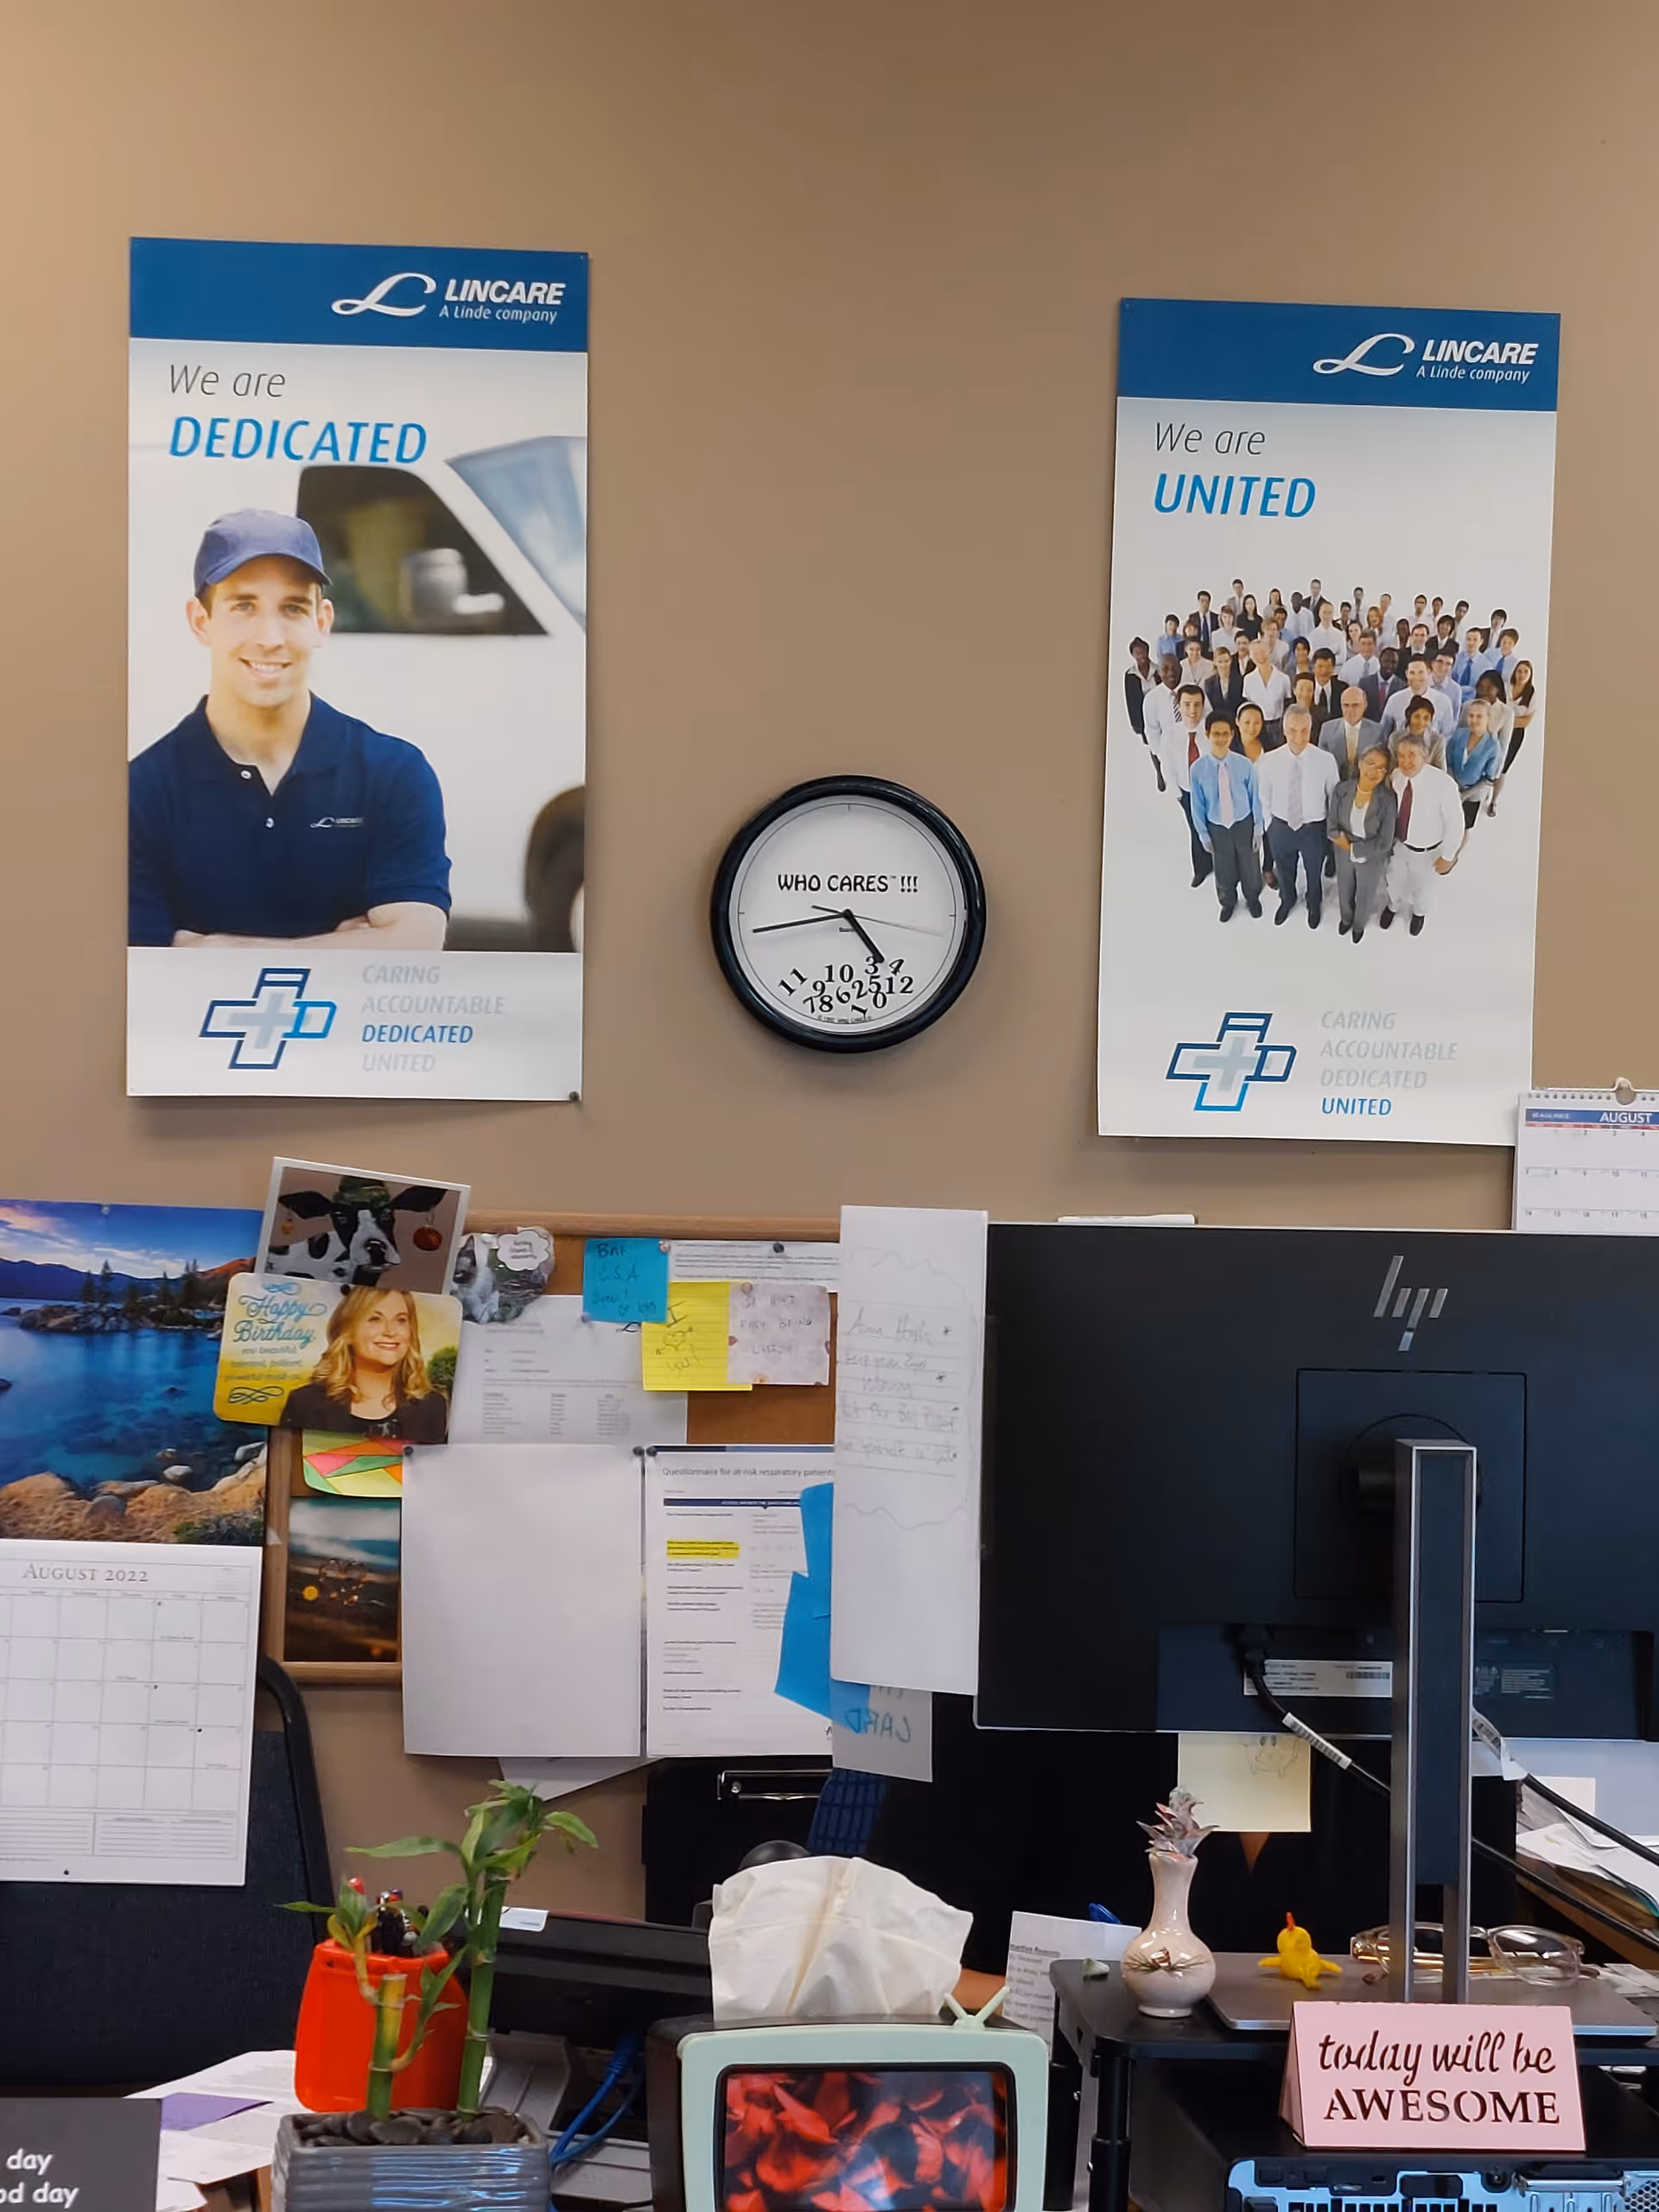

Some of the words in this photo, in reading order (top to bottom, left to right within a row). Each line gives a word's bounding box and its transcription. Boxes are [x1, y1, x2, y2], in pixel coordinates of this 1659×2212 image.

[445, 278, 566, 306] LINCARE
[439, 305, 450, 319] A
[454, 304, 492, 321] Linde
[495, 308, 558, 325] company
[1421, 339, 1539, 365] LINCARE
[169, 364, 219, 396] We
[232, 372, 286, 398] are
[1415, 365, 1427, 378] A
[1430, 364, 1466, 380] Linde
[1469, 367, 1531, 385] company
[168, 415, 428, 465] DEDICATED
[1154, 422, 1203, 454] We
[1214, 430, 1267, 456] are
[1153, 473, 1316, 518] UNITED
[778, 874, 822, 892] WHO
[899, 875, 919, 893] !!!
[362, 965, 441, 985] CARING
[825, 963, 855, 983] 10
[864, 956, 880, 976] 3
[888, 958, 905, 976] 4
[778, 968, 808, 996] 11
[812, 980, 827, 998] 9
[851, 979, 868, 1000] 2
[868, 976, 881, 994] 5
[885, 976, 914, 995] 12
[803, 995, 817, 1014] 7
[819, 995, 834, 1013] 8
[836, 985, 851, 1004] 6
[361, 995, 506, 1015] ACCOUNTABLE
[1320, 1011, 1396, 1031] CARING
[361, 1024, 474, 1044] DEDICATED
[1319, 1039, 1458, 1061] ACCOUNTABLE
[361, 1053, 435, 1073] UNITED
[1320, 1070, 1427, 1089] DEDICATED
[1321, 1096, 1392, 1116] UNITED
[1599, 1112, 1652, 1123] AUGUST
[238, 1295, 327, 1322] Happy
[1373, 1255, 1448, 1352] hp
[662, 1466, 718, 1478] Questionnaire
[720, 1467, 731, 1476] for
[759, 1467, 802, 1478] respiratory
[22, 1562, 99, 1582] AUGUST
[105, 1569, 149, 1583] 2022
[1318, 2030, 1422, 2087] today
[1433, 2031, 1506, 2073] will
[1513, 2031, 1556, 2075] be
[1324, 2088, 1560, 2125] AWESOME
[7, 2148, 53, 2175] day
[32, 2182, 79, 2209] day
